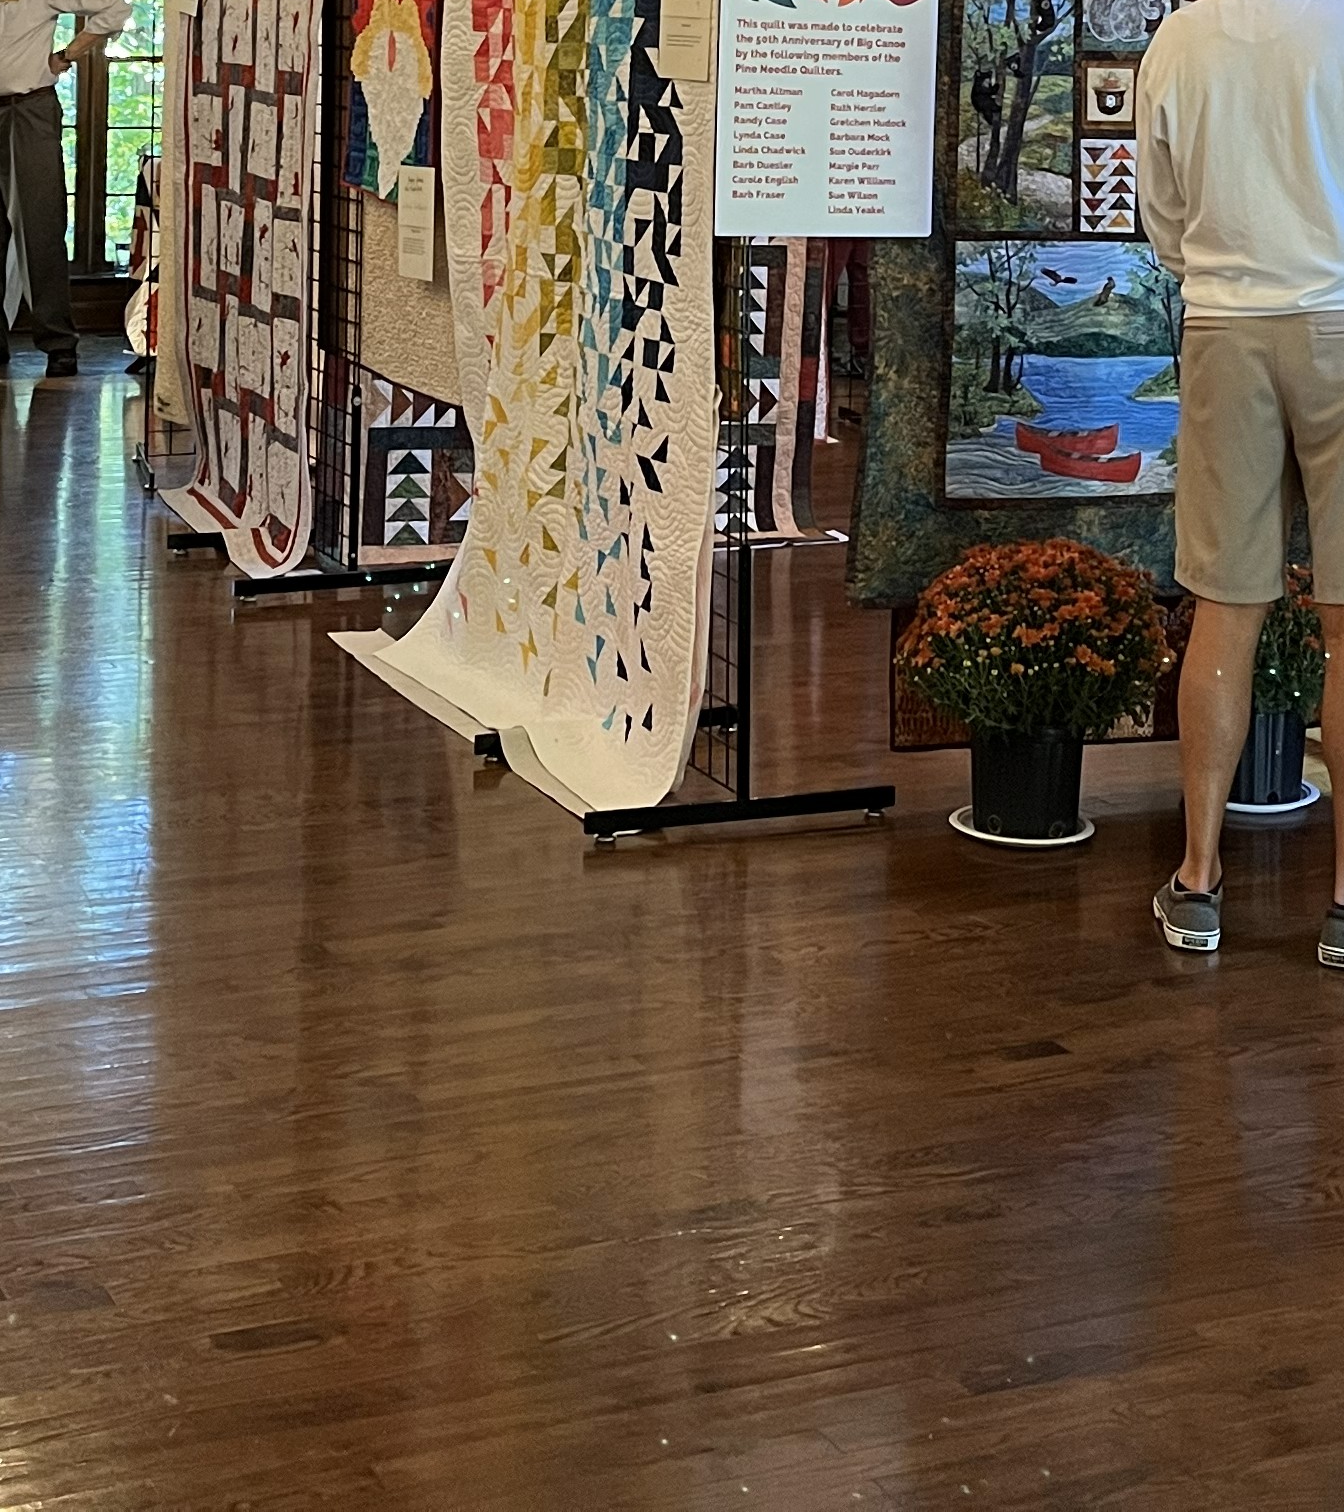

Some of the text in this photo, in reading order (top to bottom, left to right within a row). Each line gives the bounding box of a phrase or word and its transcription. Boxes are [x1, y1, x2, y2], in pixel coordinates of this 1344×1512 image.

[737, 18, 903, 34] This quilt was made to celebrate
[736, 34, 906, 49] the 50th Anniversary of Big Canoe
[735, 48, 901, 63] by the following members of the
[735, 63, 844, 76] Pine Needle Quilters.
[734, 86, 767, 95] Martha
[830, 88, 900, 100] Carol Hagadorn
[734, 101, 754, 109] Pam
[830, 103, 852, 112] Ruth
[734, 115, 788, 127] Randy Case
[830, 117, 906, 128] Gretchen Hudock
[733, 130, 786, 142] Lynda Case
[830, 132, 890, 142] Barbara Mock
[733, 145, 806, 155] Linda Chadwick
[829, 147, 891, 156] Sue Ouderkirk
[732, 160, 755, 169] Barb
[829, 161, 880, 172] Margie Parr
[732, 175, 799, 187] Carole English
[828, 176, 896, 185] Karen Williams
[732, 189, 785, 199] Barb Fraser
[828, 191, 878, 200] Sue Wilson
[827, 205, 885, 215] Linda Yeakel
